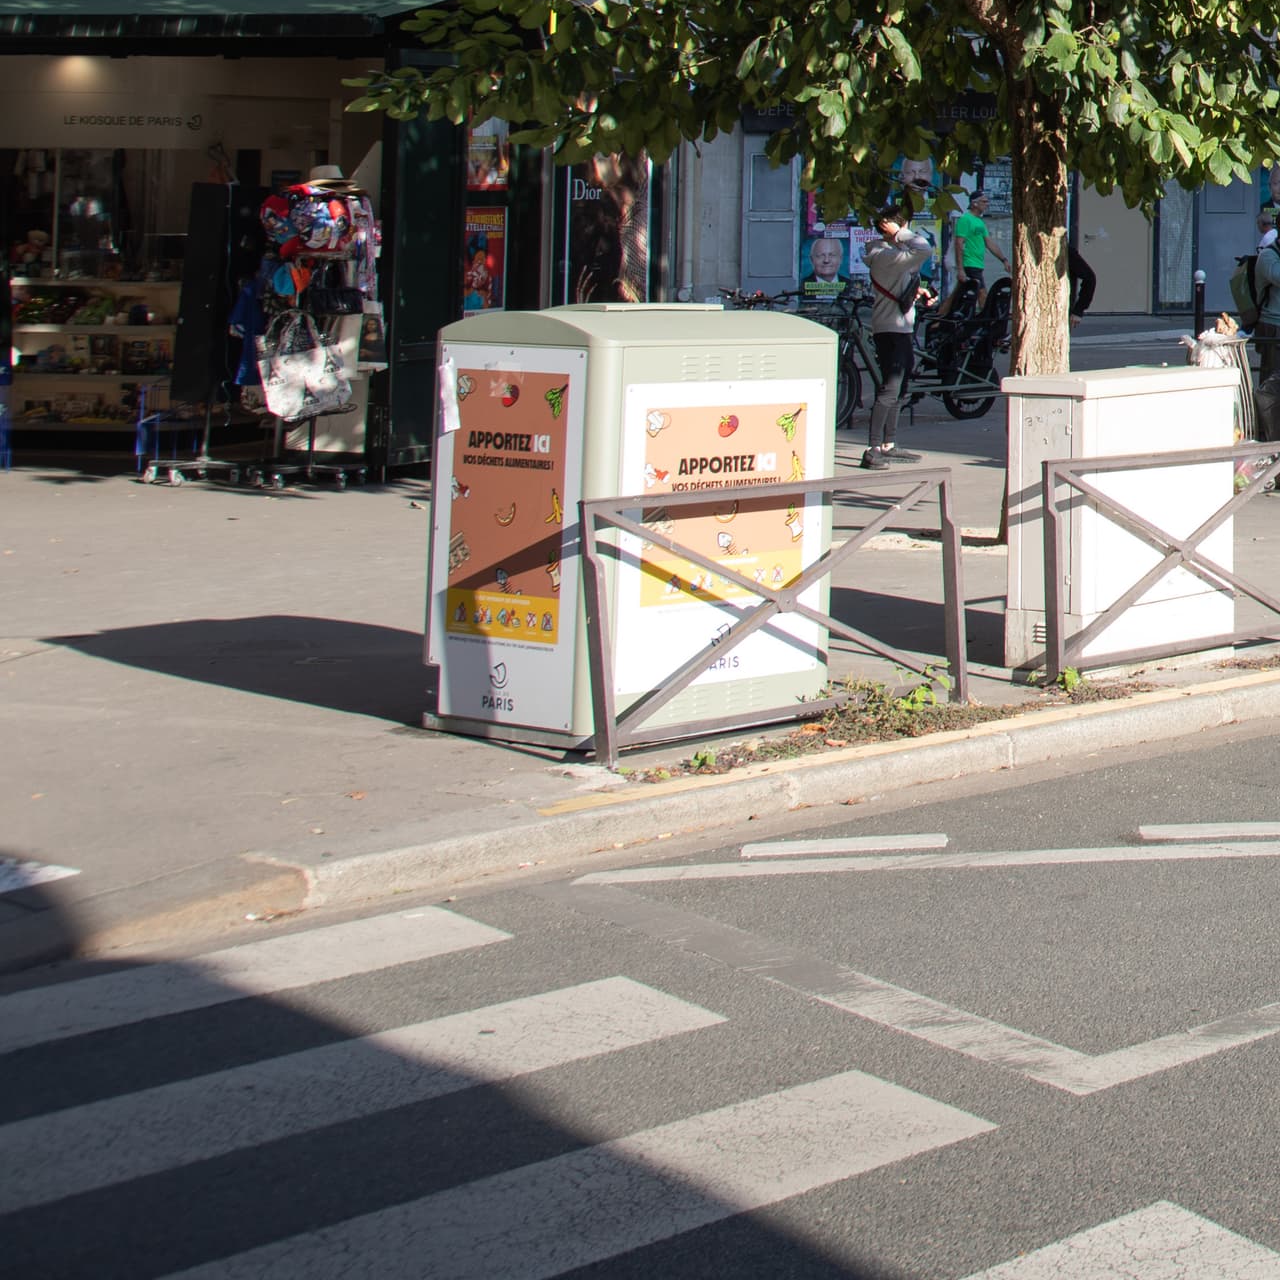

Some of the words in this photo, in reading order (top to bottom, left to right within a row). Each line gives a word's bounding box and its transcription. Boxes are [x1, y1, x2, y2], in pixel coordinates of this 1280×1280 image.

[63, 115, 78, 125] LE
[80, 115, 127, 126] KIOSQUE
[129, 116, 145, 126] DE
[147, 116, 183, 127] PARIS
[572, 178, 602, 200] Dior
[468, 430, 532, 452] APPORTEZ
[534, 434, 551, 453] ICI
[463, 454, 477, 465] VOS
[477, 453, 504, 466] DÉCHETS
[504, 457, 550, 470] ALIMENTAIRES
[678, 454, 755, 475] APPORTEZ
[672, 482, 689, 492] VOS
[690, 479, 723, 491] DÉCHETS
[709, 656, 740, 671] ARIS
[482, 696, 514, 711] PARIS
